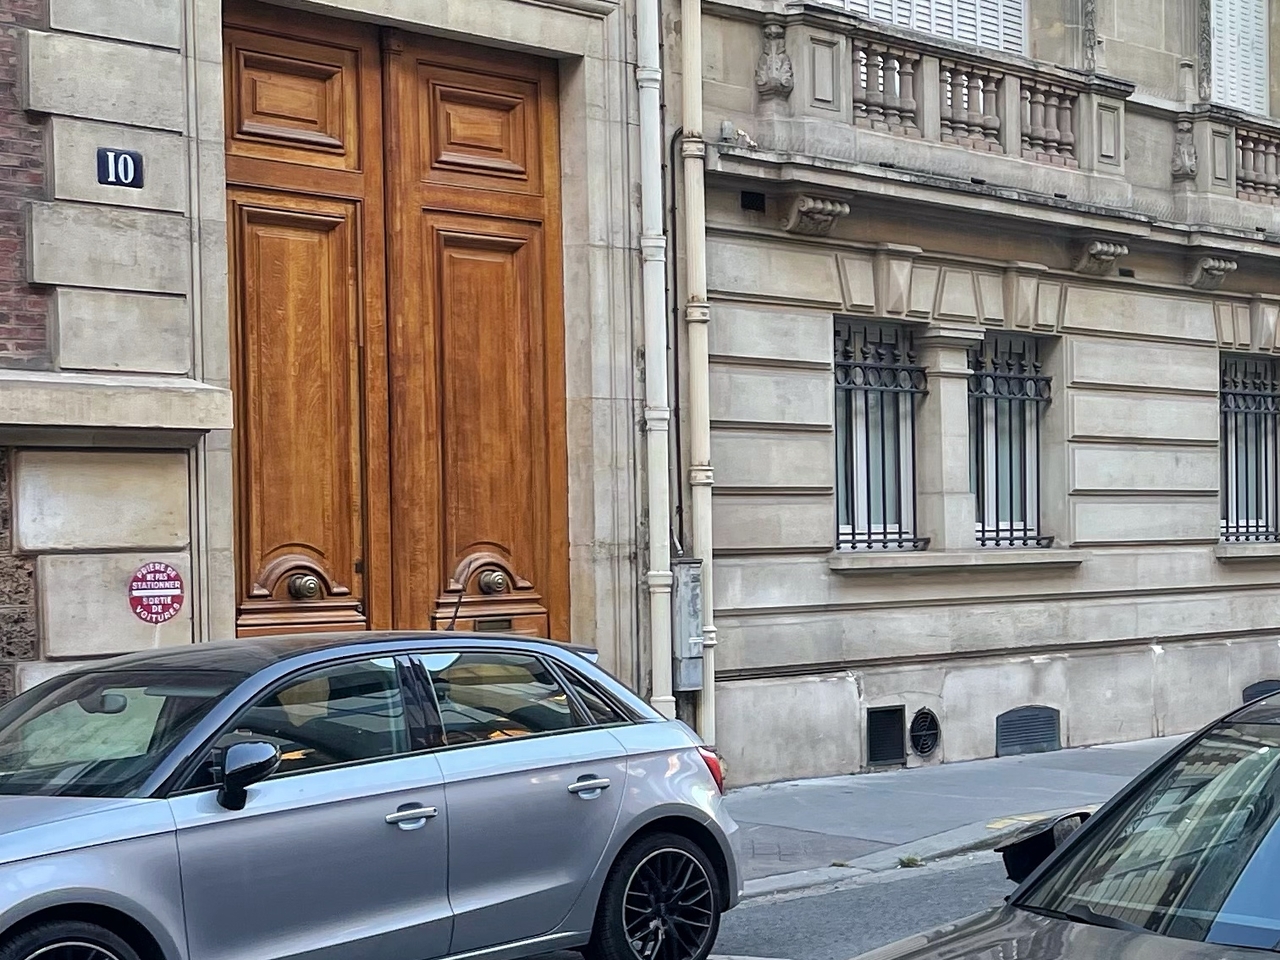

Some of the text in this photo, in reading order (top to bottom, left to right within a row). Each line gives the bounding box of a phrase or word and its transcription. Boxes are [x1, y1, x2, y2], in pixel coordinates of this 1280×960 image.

[106, 151, 135, 184] 10
[146, 572, 168, 581] NE PAS
[166, 566, 178, 578] DE
[132, 580, 181, 590] STATIONNER
[142, 596, 172, 605] SORTIE
[136, 602, 180, 622] VOITURES
[151, 605, 163, 613] DE
